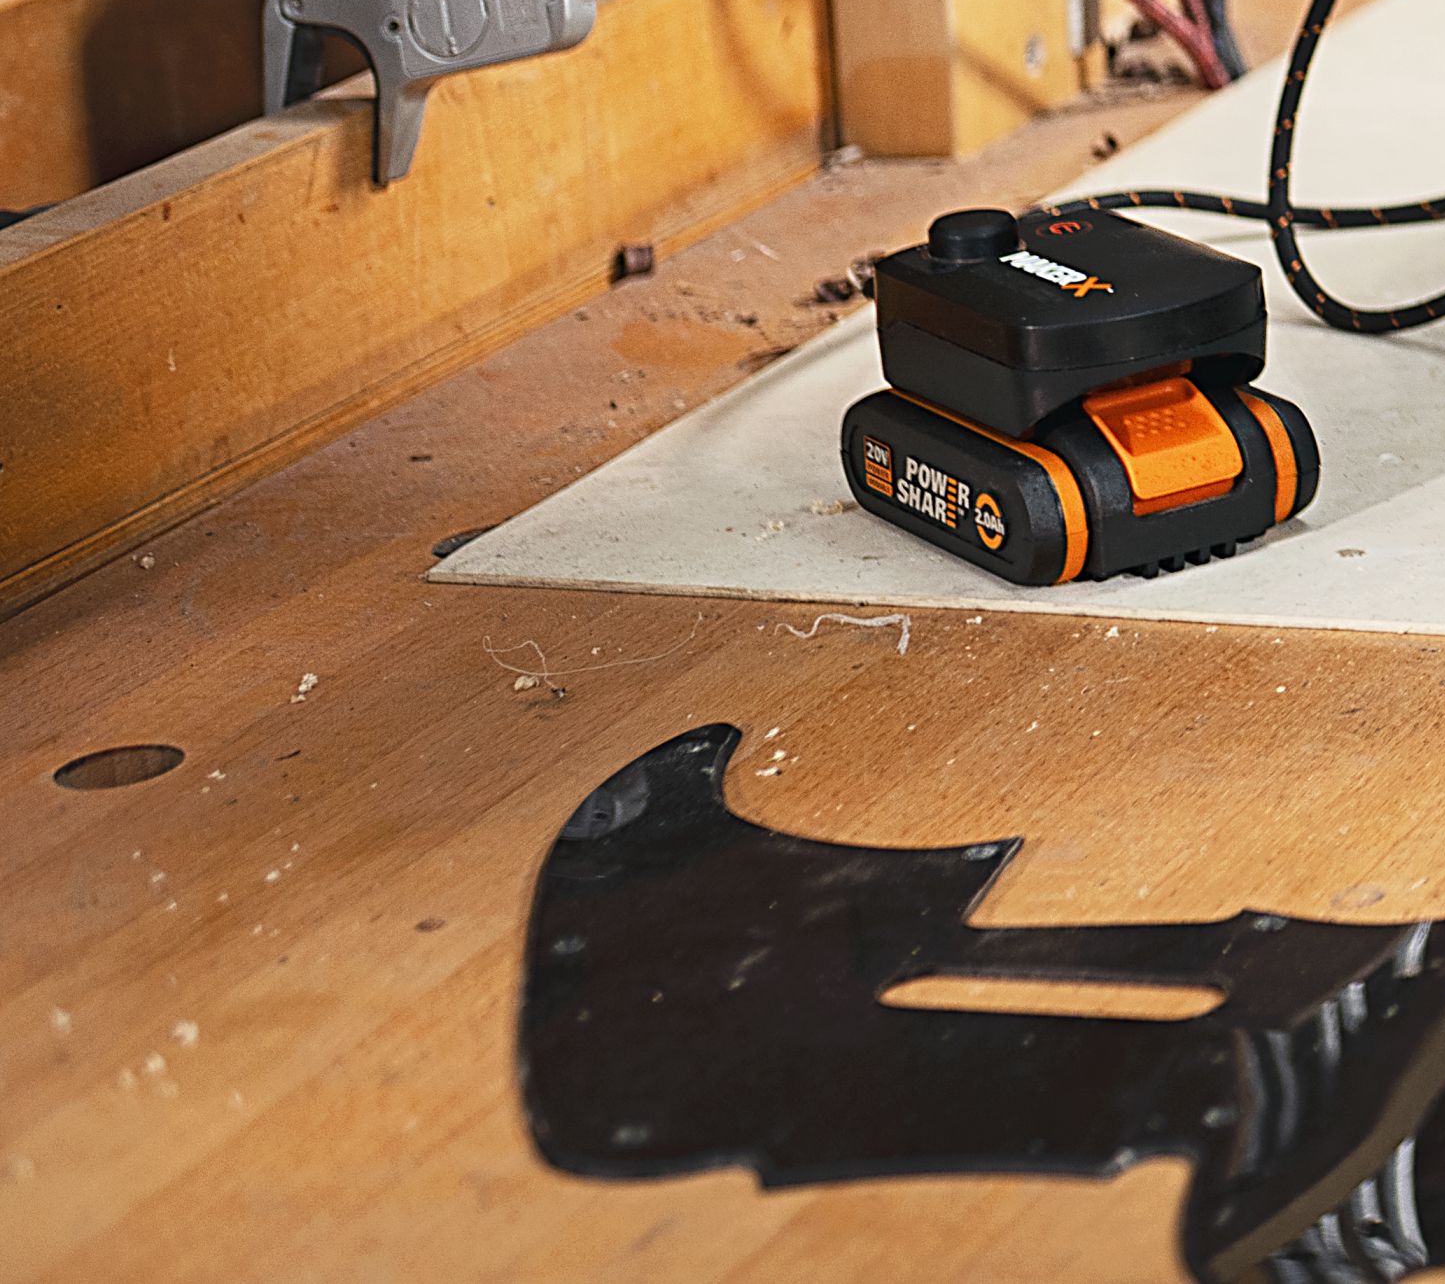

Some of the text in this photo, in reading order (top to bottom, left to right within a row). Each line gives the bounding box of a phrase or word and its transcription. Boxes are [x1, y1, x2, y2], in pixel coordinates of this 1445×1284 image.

[865, 441, 890, 467] 20V
[905, 455, 971, 510] POWER
[895, 477, 958, 529] SHARE
[974, 507, 1006, 536] 2.0Ah
